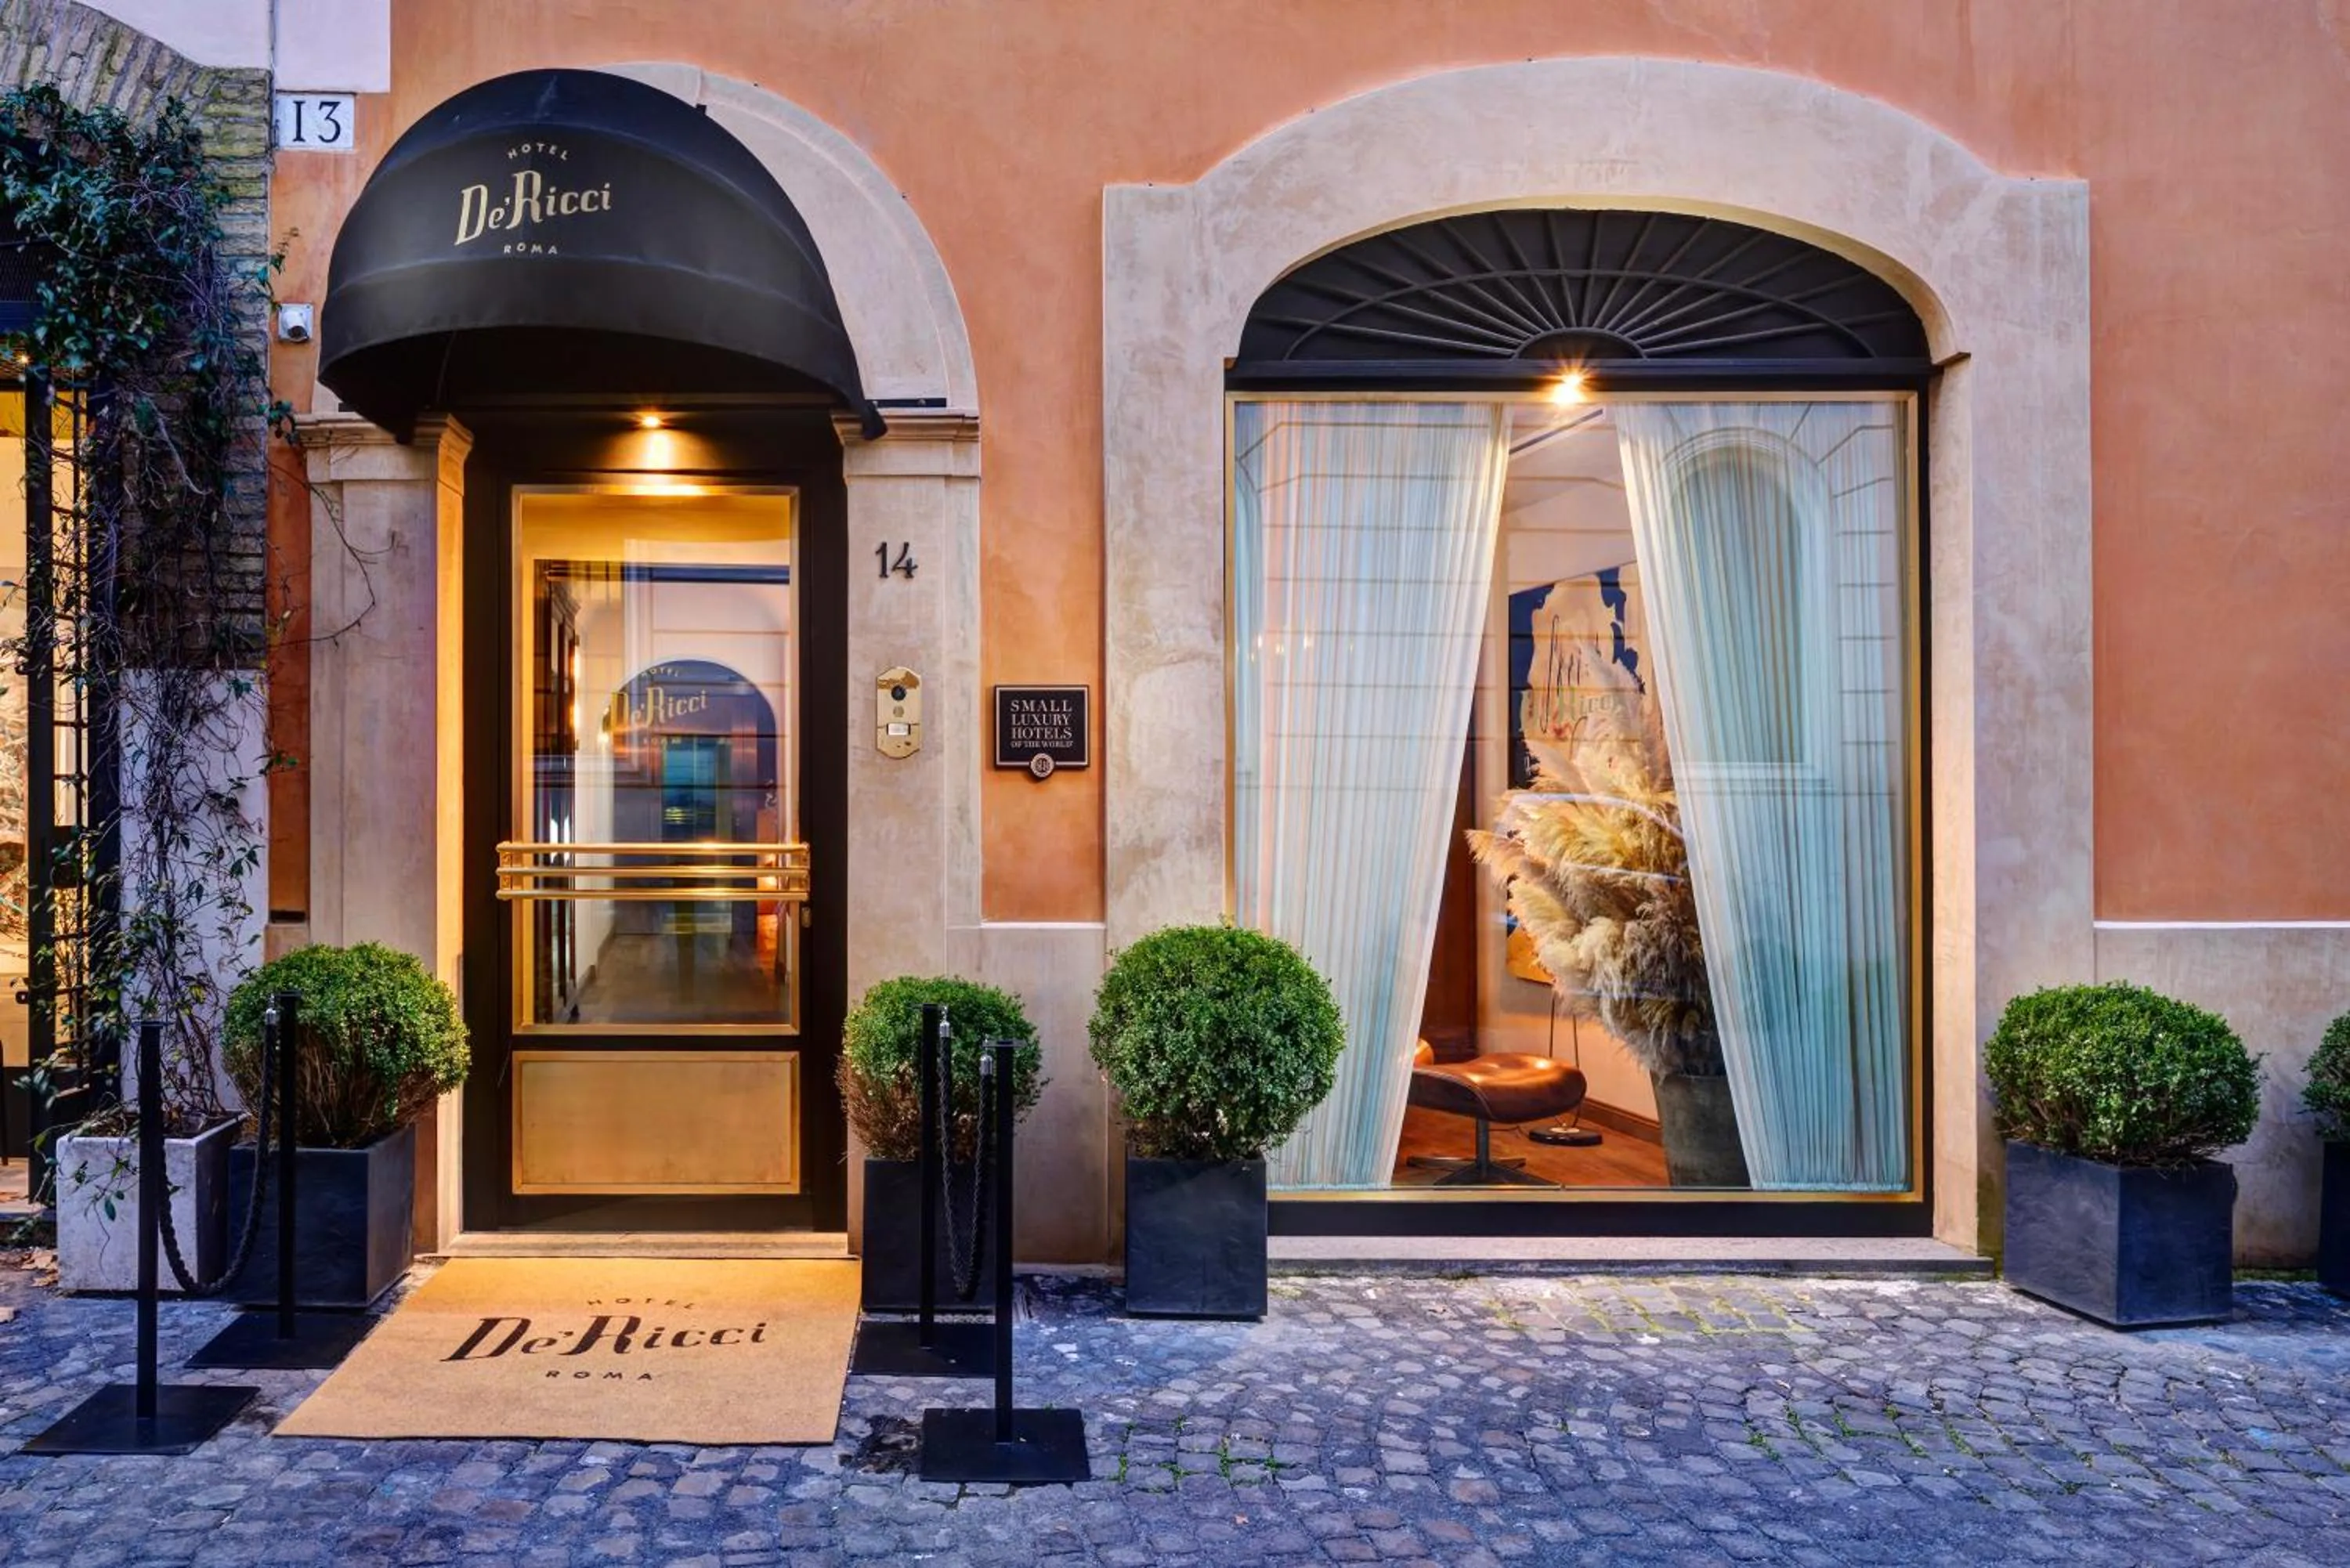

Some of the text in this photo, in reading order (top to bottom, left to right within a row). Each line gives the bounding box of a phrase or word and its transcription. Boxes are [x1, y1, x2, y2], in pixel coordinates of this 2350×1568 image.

[292, 99, 342, 143] 13
[508, 143, 568, 160] HOTEL
[504, 242, 558, 255] ROMA
[875, 541, 918, 579] 14
[1010, 699, 1072, 712] SMALL
[1011, 714, 1071, 725] LUXURY
[1012, 727, 1072, 739] HOTELS
[587, 1297, 696, 1310] HOTEL
[545, 1370, 653, 1382] ROMA
